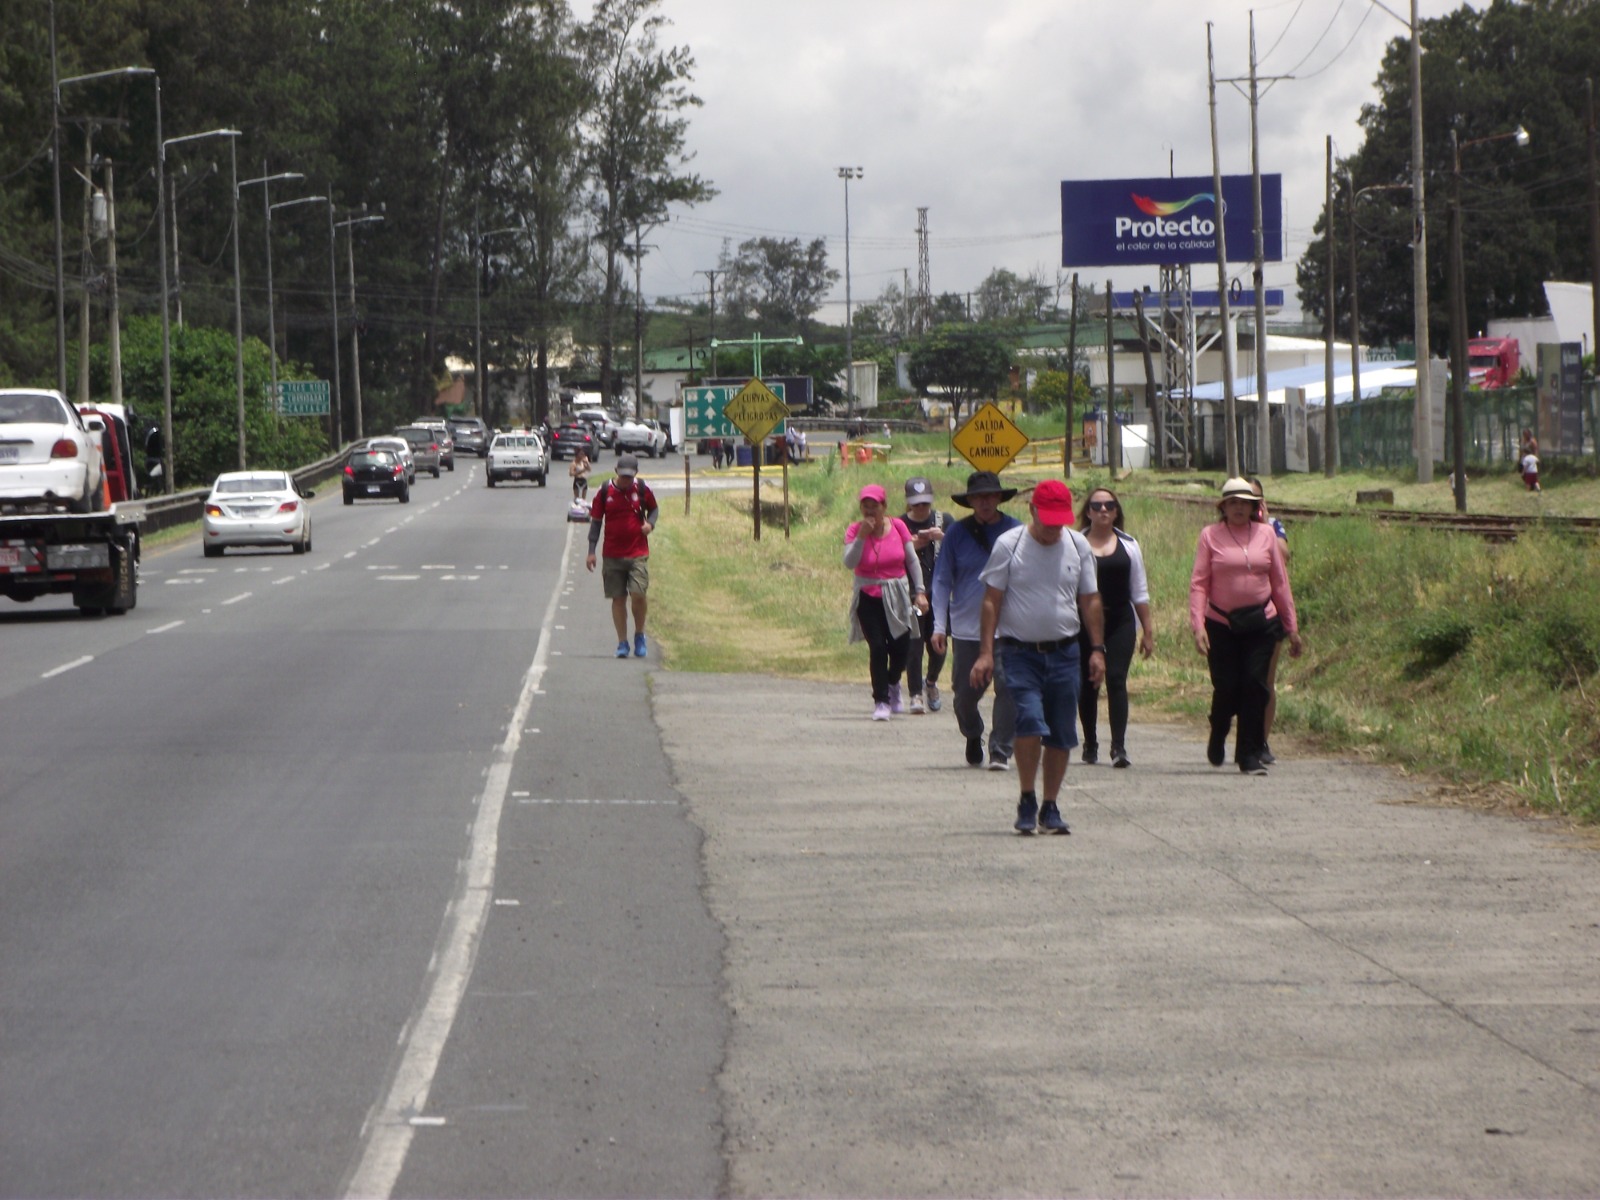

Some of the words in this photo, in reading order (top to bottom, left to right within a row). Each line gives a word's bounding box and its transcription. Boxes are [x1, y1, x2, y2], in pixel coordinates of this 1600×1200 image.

[1115, 214, 1215, 238] Protecto
[1116, 242, 1125, 251] el
[1127, 241, 1151, 251] color
[1153, 240, 1166, 250] de
[1167, 240, 1177, 250] la
[1179, 239, 1215, 249] calidad
[742, 393, 770, 403] CURVAS
[734, 409, 778, 421] PELIGROSAS
[974, 420, 1005, 431] SALIDA
[985, 433, 995, 444] DE
[969, 446, 1010, 458] CAMIONES
